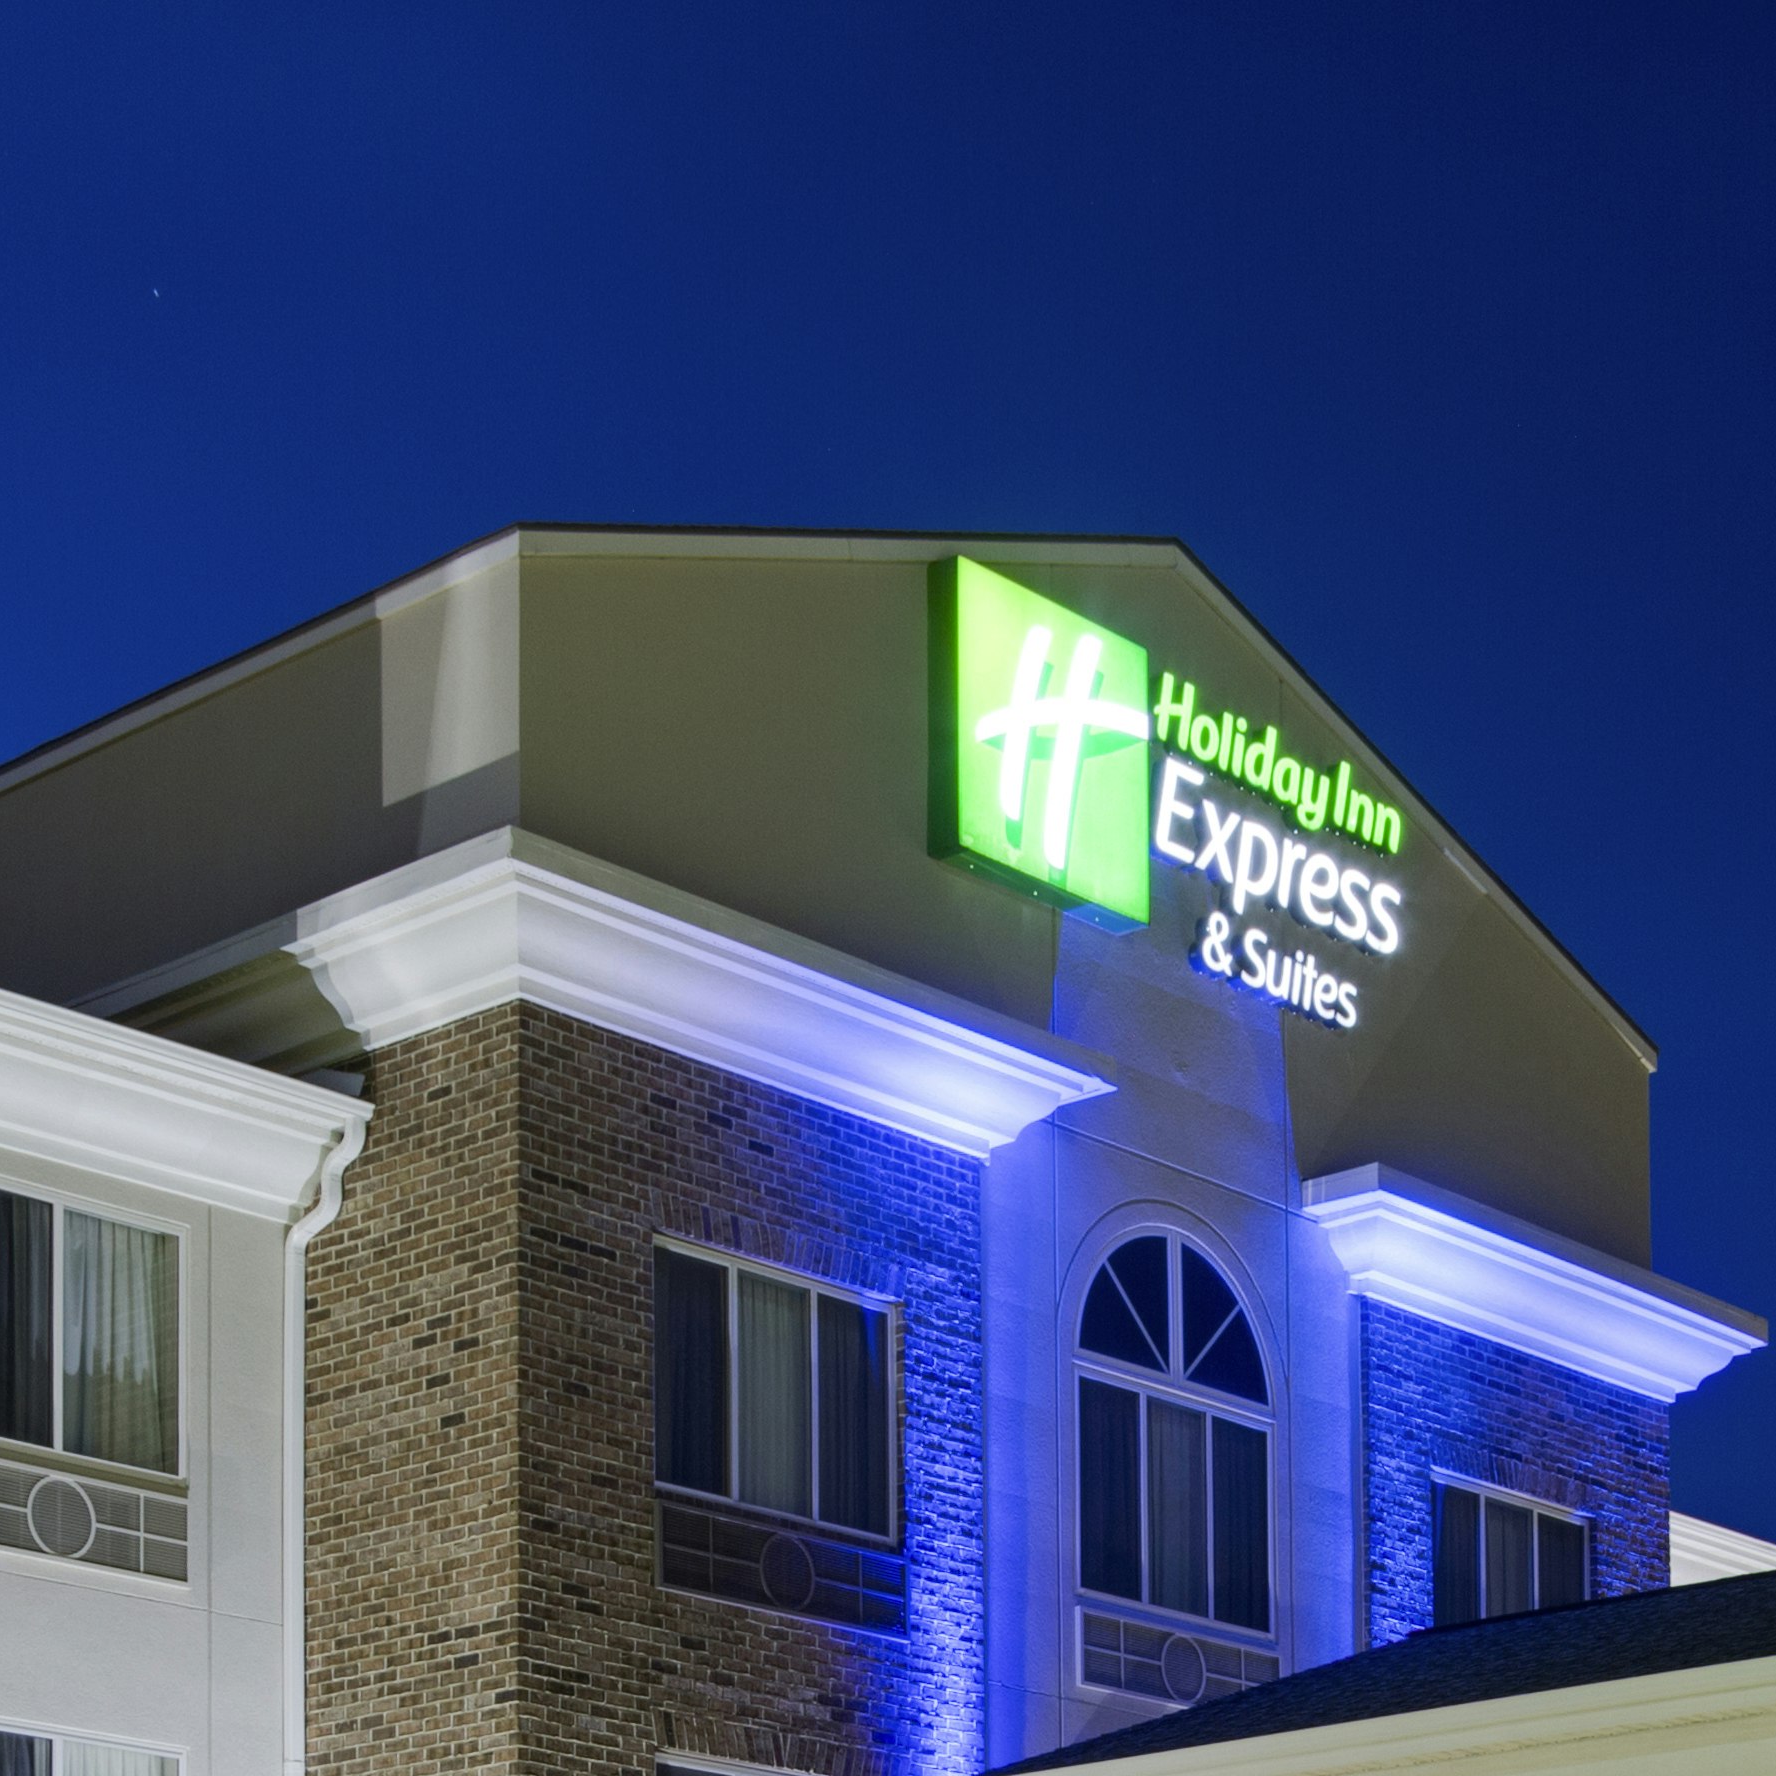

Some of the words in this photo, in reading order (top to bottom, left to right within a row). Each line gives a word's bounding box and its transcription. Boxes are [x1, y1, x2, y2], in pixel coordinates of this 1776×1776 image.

[1154, 671, 1330, 831] Holiday
[1333, 760, 1401, 854] Inn
[1155, 757, 1401, 954] Express
[1202, 911, 1233, 977] &
[1240, 928, 1358, 1028] Suites
